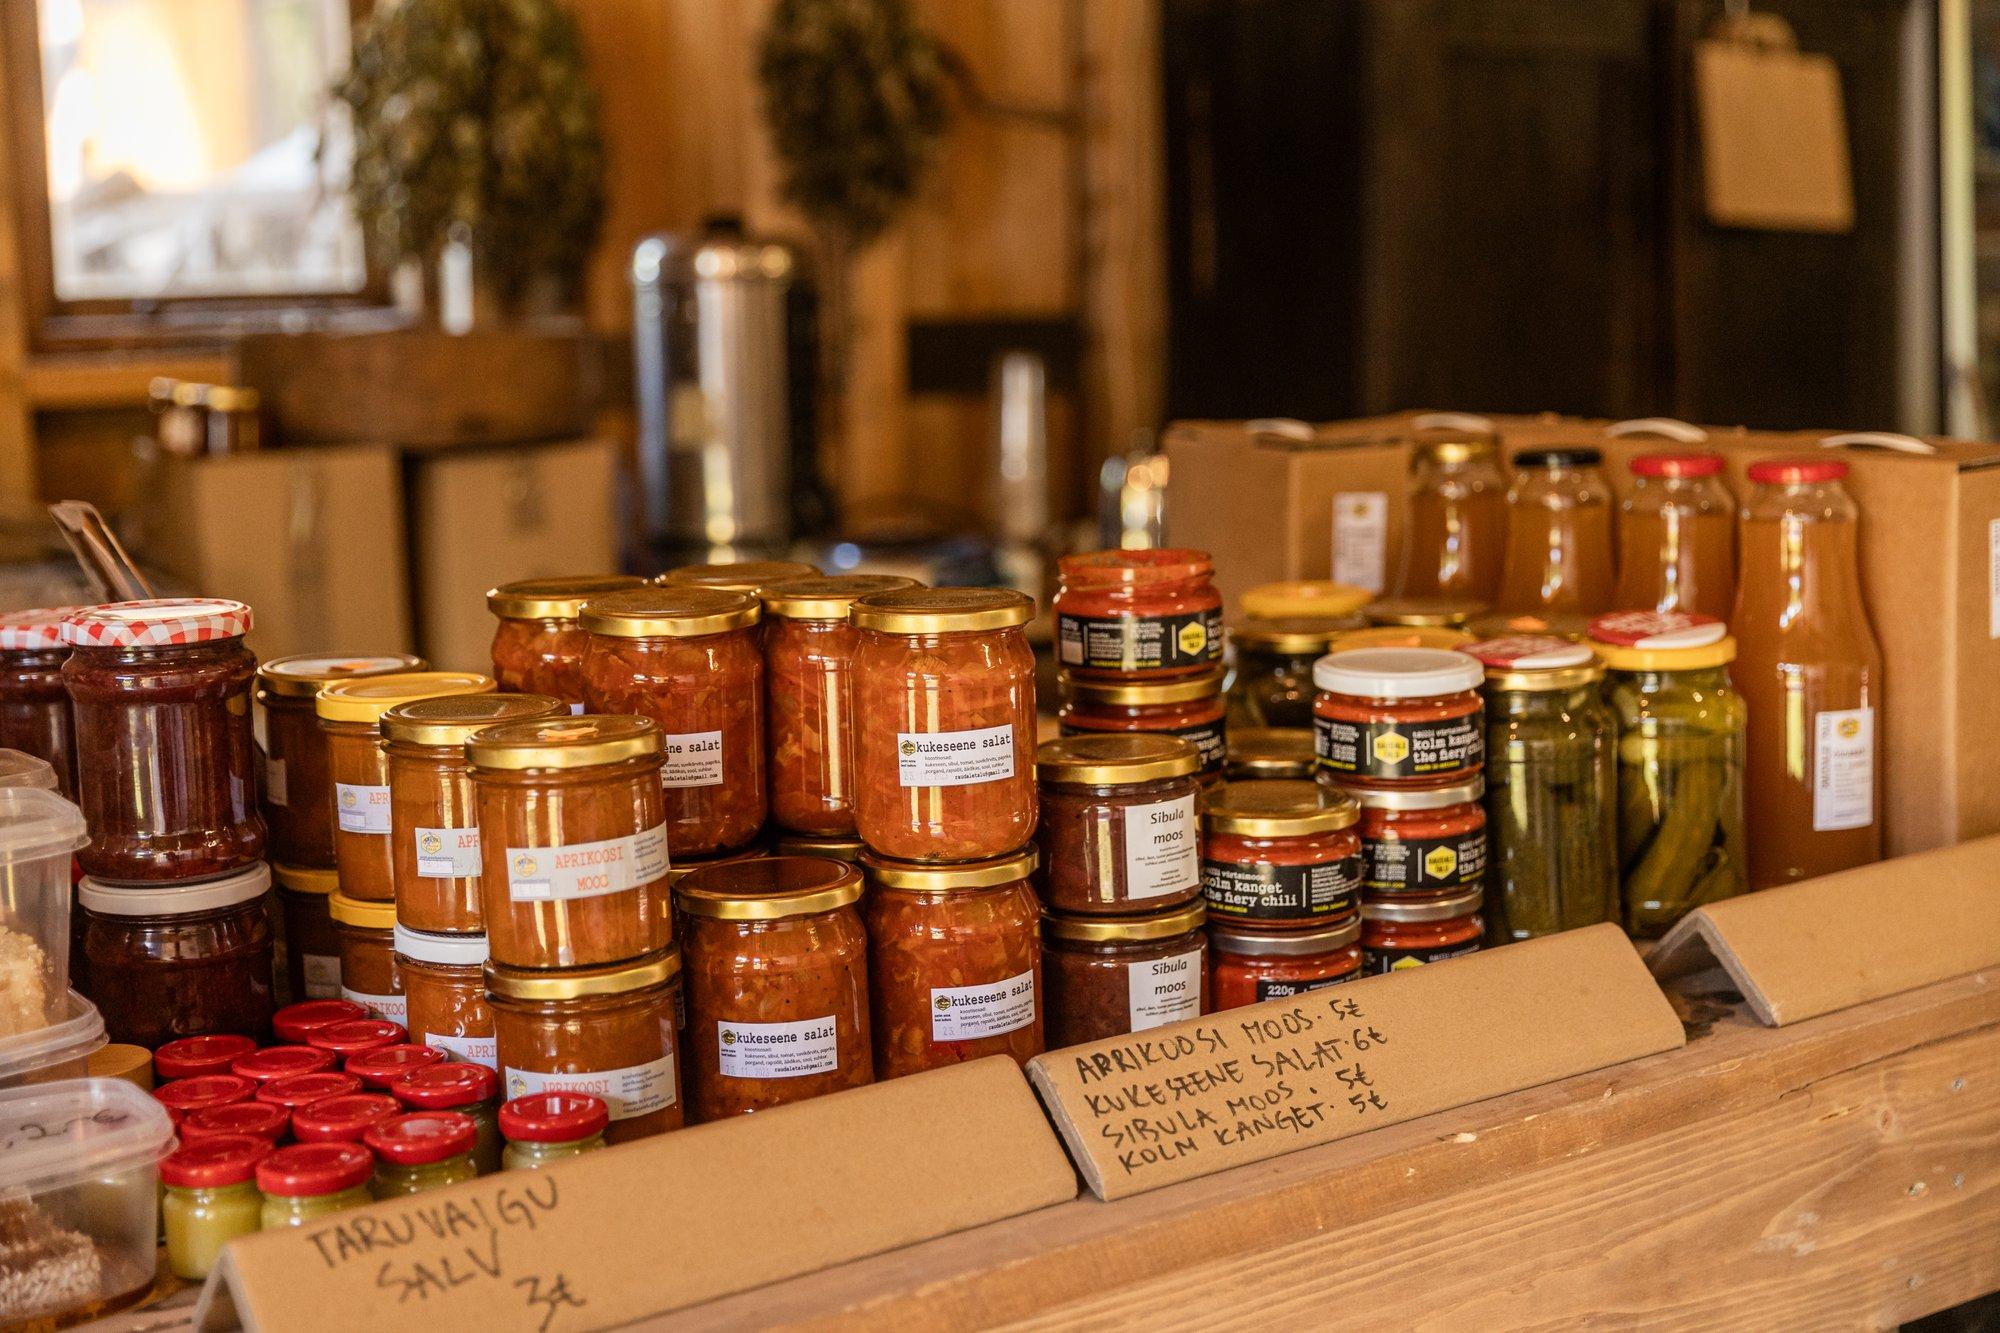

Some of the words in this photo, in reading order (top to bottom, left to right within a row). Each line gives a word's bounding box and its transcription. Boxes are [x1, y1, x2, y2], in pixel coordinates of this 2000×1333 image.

[689, 740, 720, 753] salat
[916, 741, 976, 753] kukeseene
[982, 733, 1011, 748] salat
[1413, 737, 1446, 751] kolm
[1413, 750, 1437, 763] the
[1150, 807, 1184, 825] Sibula
[1153, 830, 1184, 845] moos
[555, 846, 624, 869] APRIKOOSI
[1234, 879, 1283, 895] kanget
[1224, 891, 1258, 907] fiery
[1261, 894, 1298, 907] chili
[1151, 958, 1187, 976] Sibula
[951, 989, 1007, 1007] kukeseene
[1011, 979, 1033, 997] salat
[1154, 979, 1187, 996] moos
[736, 1031, 797, 1044] kukeseene
[804, 1025, 835, 1041] salat
[1083, 1059, 1244, 1118] KUKESEENE
[1102, 1107, 1217, 1148] SIBULA
[306, 1174, 559, 1269] TARUVAIGU
[375, 1227, 502, 1304] SALV
